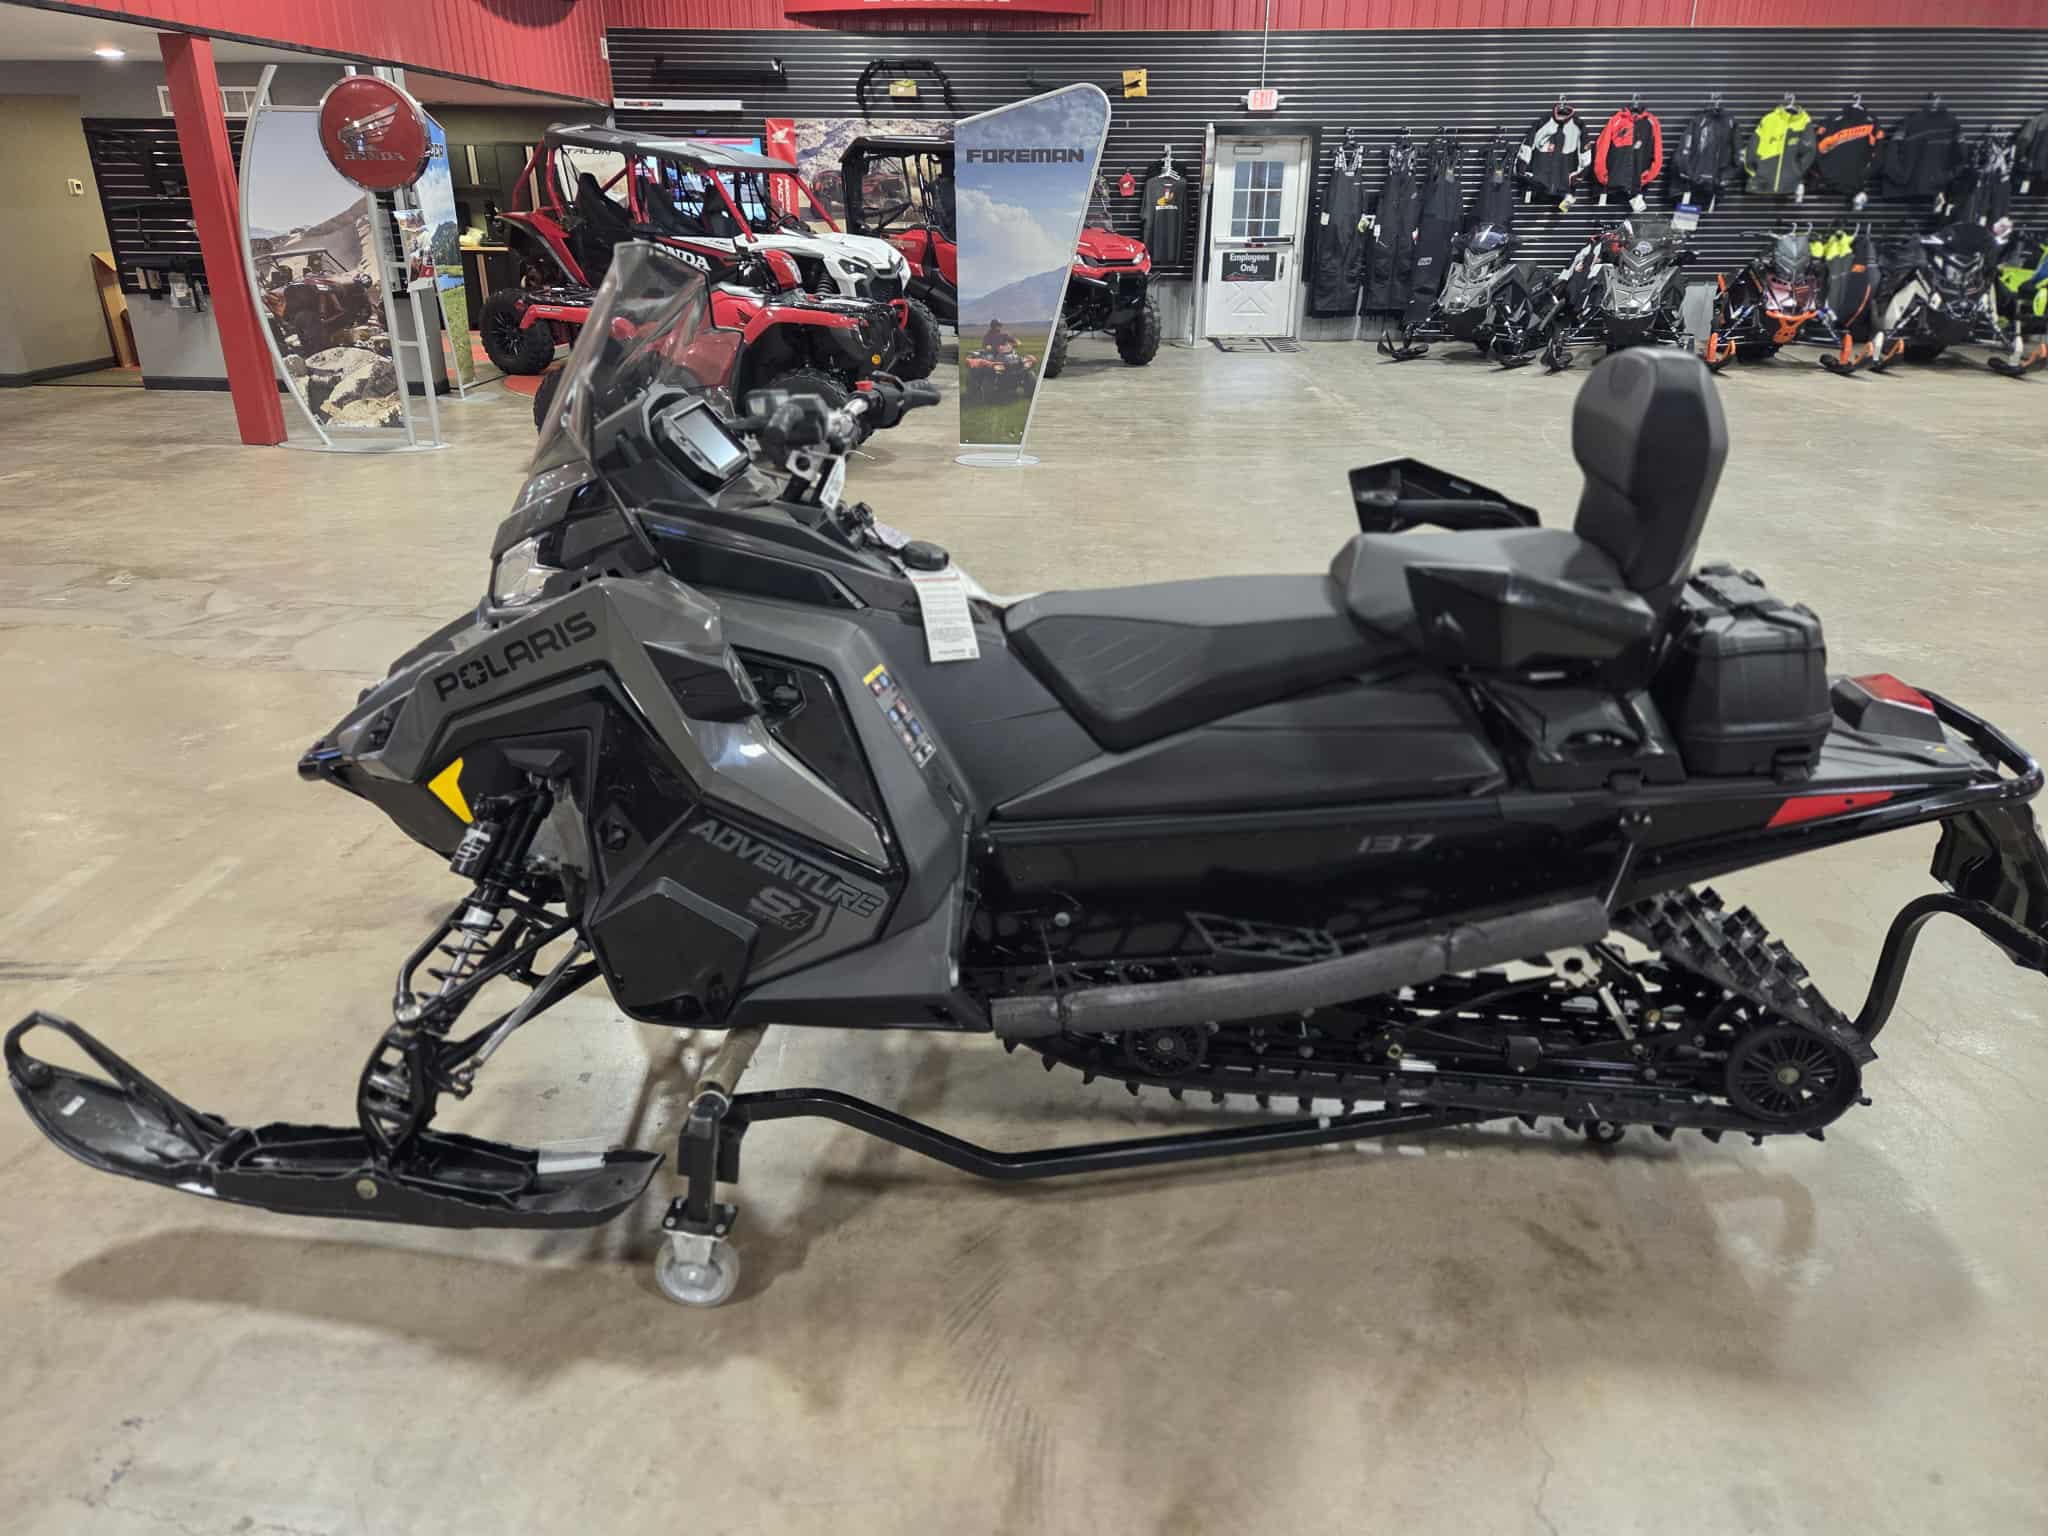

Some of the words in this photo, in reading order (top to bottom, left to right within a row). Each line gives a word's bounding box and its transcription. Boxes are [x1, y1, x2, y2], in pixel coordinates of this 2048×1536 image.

[1252, 93, 1275, 106] EXIT
[966, 149, 1084, 163] FOREMAN
[1230, 253, 1270, 263] Employees
[1240, 263, 1258, 273] Only
[433, 612, 597, 701] POLARIS
[1357, 833, 1436, 852] 137
[690, 818, 884, 919] ADVENTURE
